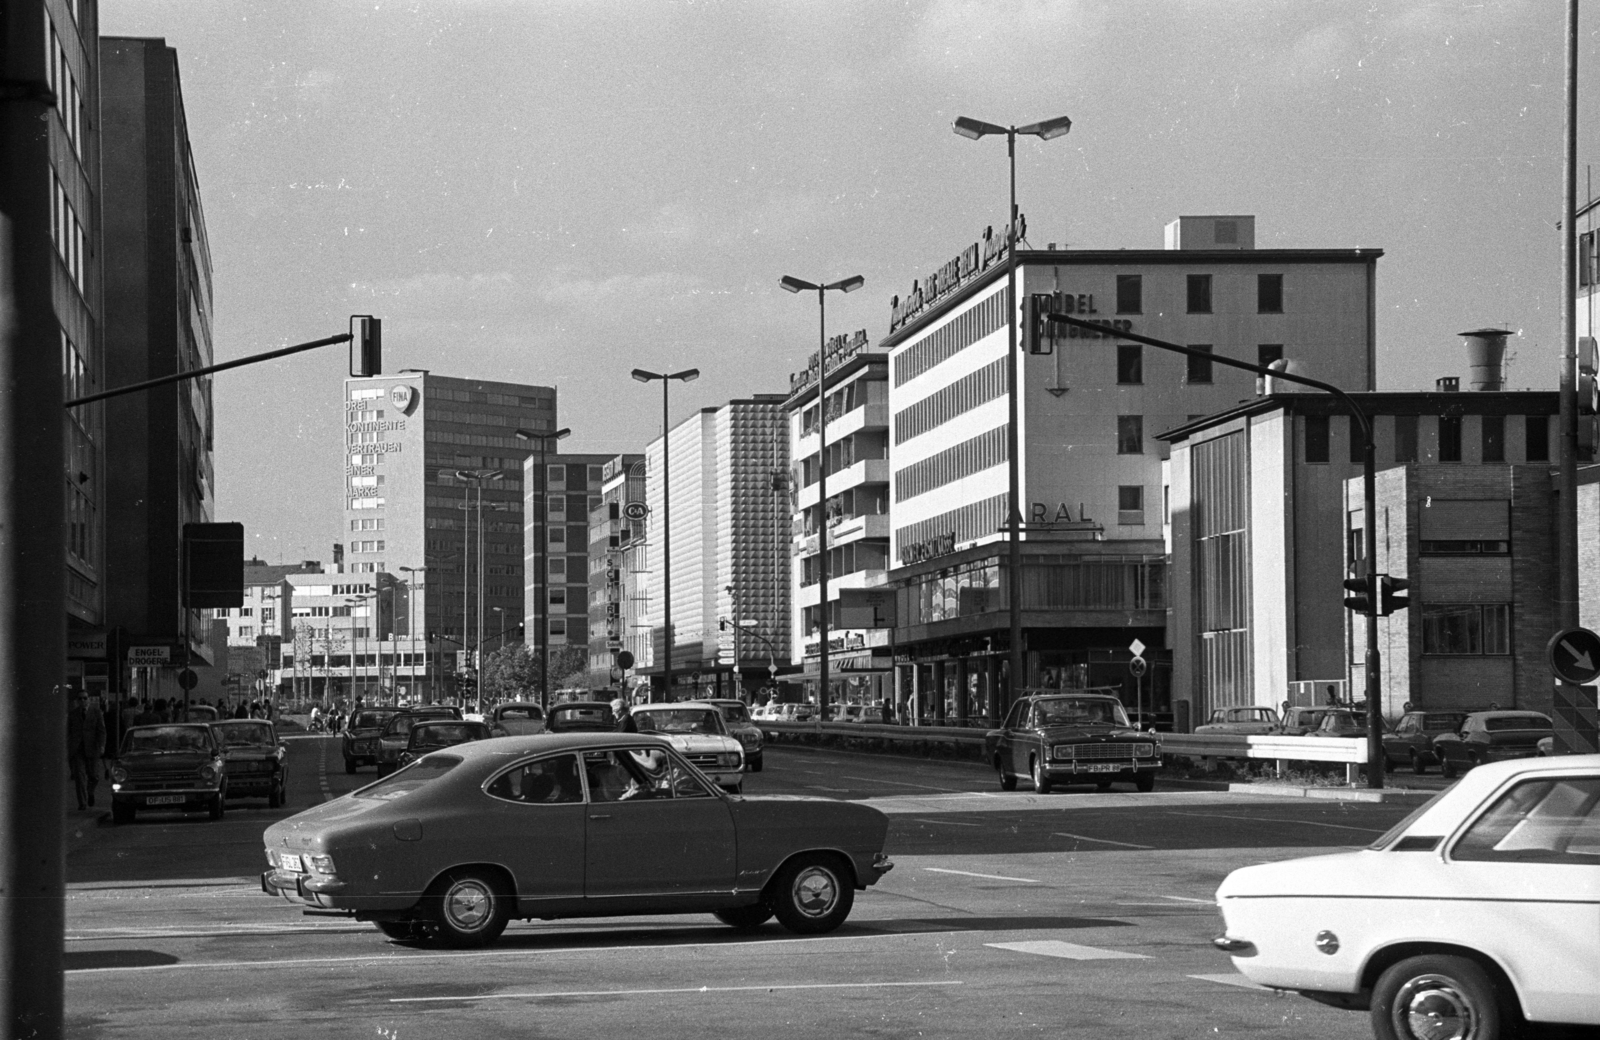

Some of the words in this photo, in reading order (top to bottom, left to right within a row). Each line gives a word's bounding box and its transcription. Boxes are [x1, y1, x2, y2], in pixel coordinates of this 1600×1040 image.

[392, 391, 408, 402] FINA
[345, 400, 368, 411] DREI
[346, 420, 406, 433] KONTINENTE
[346, 442, 402, 455] VERTRAUEN
[346, 465, 375, 476] EINER
[346, 486, 378, 498] MARKE
[628, 506, 644, 515] C&A
[135, 648, 164, 657] ENGEL-
[129, 657, 169, 665] DROGERIE
